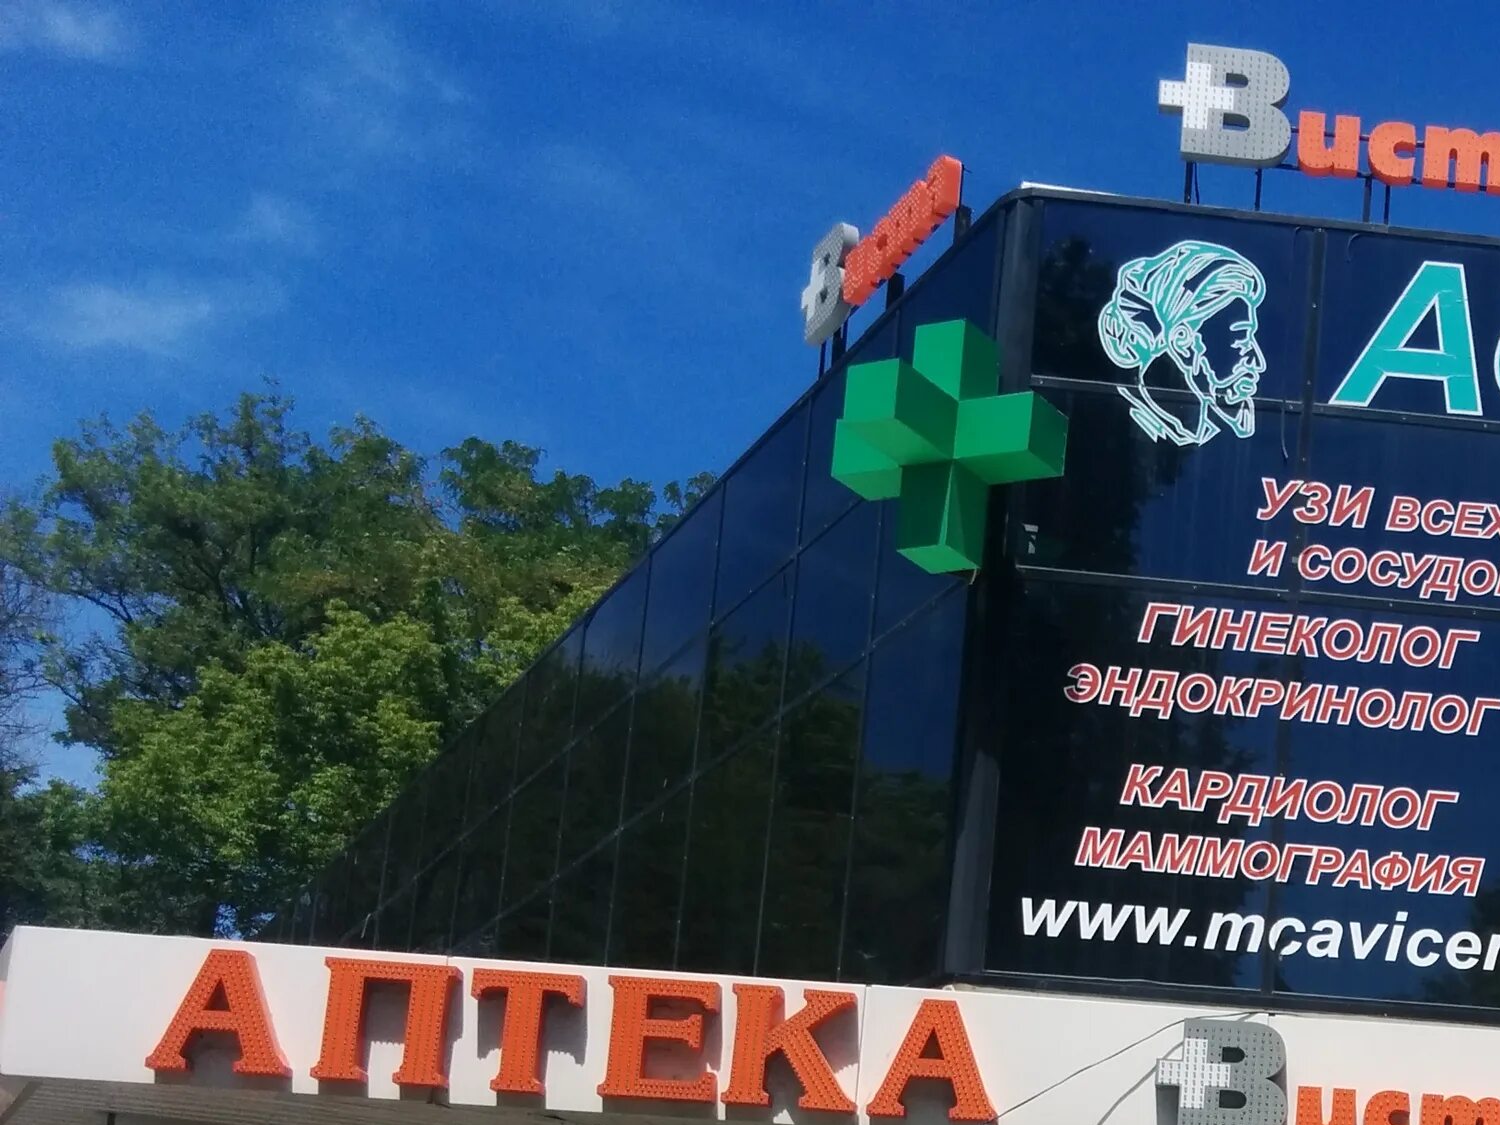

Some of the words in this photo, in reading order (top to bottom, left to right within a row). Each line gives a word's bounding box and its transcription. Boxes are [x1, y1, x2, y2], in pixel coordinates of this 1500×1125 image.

[1257, 477, 1374, 528] УЗИ
[1247, 540, 1287, 577] И
[1137, 602, 1479, 669] ГИНЕКОЛОГ
[1119, 764, 1459, 832] КАРДИОЛОГ
[1075, 827, 1485, 897] МАММОГРАФИЯ
[145, 949, 998, 1122] АПТЕКА
